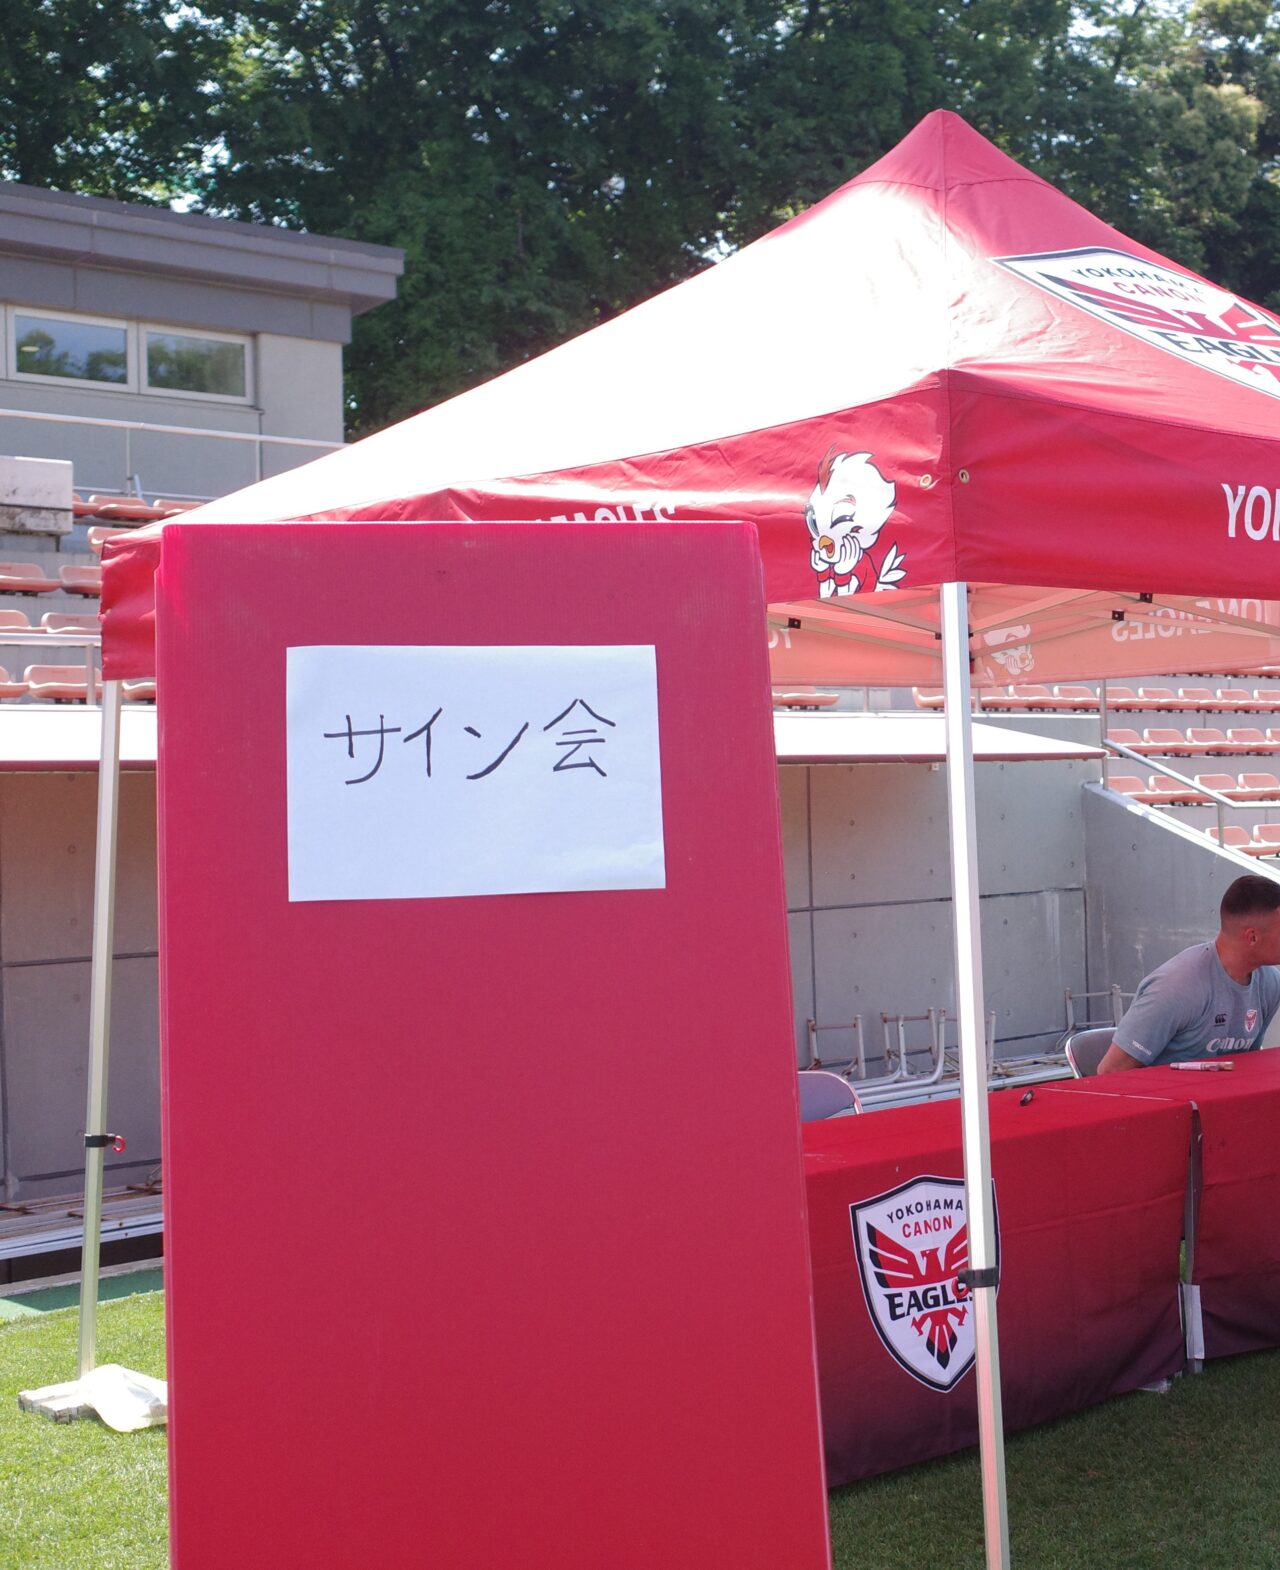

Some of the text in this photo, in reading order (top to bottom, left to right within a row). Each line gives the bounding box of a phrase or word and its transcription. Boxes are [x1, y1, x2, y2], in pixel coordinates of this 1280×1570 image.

[1113, 281, 1207, 304] CANON
[323, 698, 617, 785] サイン会
[886, 1198, 964, 1224] YOKOHAMA
[902, 1215, 953, 1238] CANON
[883, 1281, 973, 1321] EAGLE
